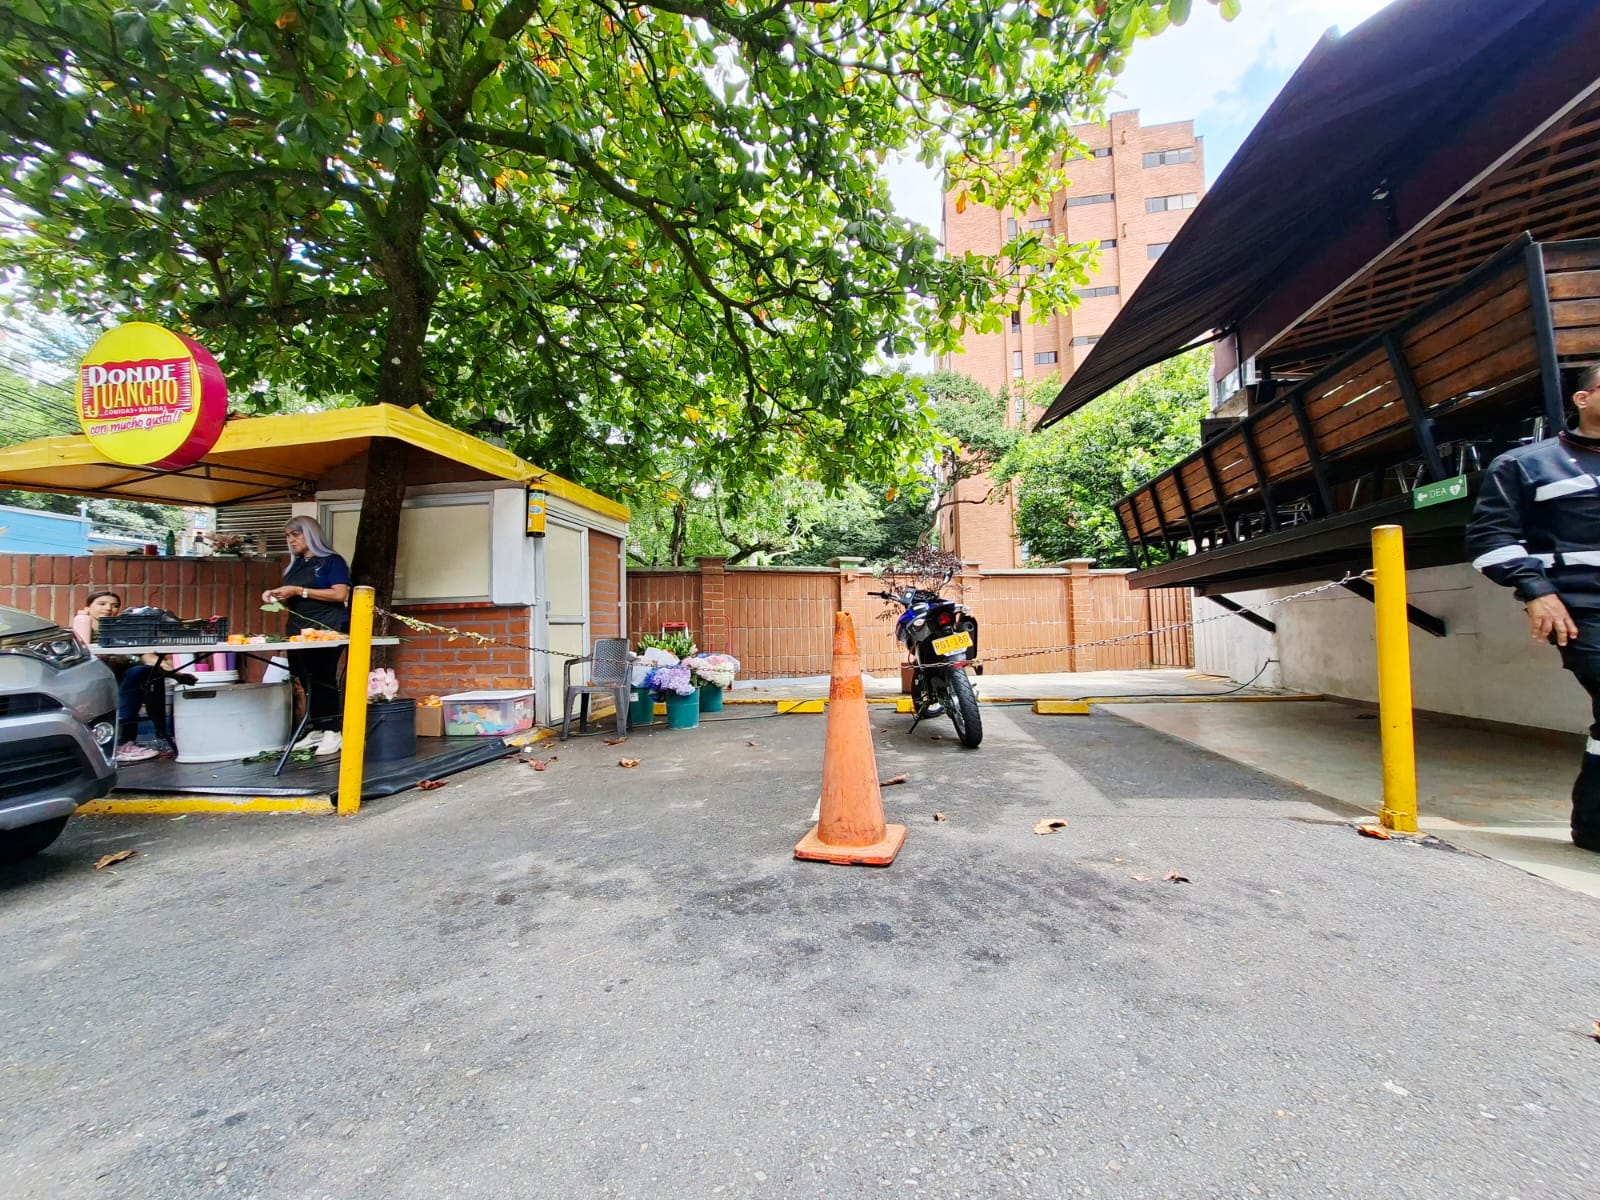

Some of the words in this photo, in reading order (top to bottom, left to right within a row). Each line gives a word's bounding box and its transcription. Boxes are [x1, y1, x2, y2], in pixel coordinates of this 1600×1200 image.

[89, 364, 177, 386] DONDE
[86, 379, 179, 418] JUANCHO
[90, 424, 107, 435] con
[111, 417, 143, 432] mucho
[1431, 488, 1447, 497] DEA
